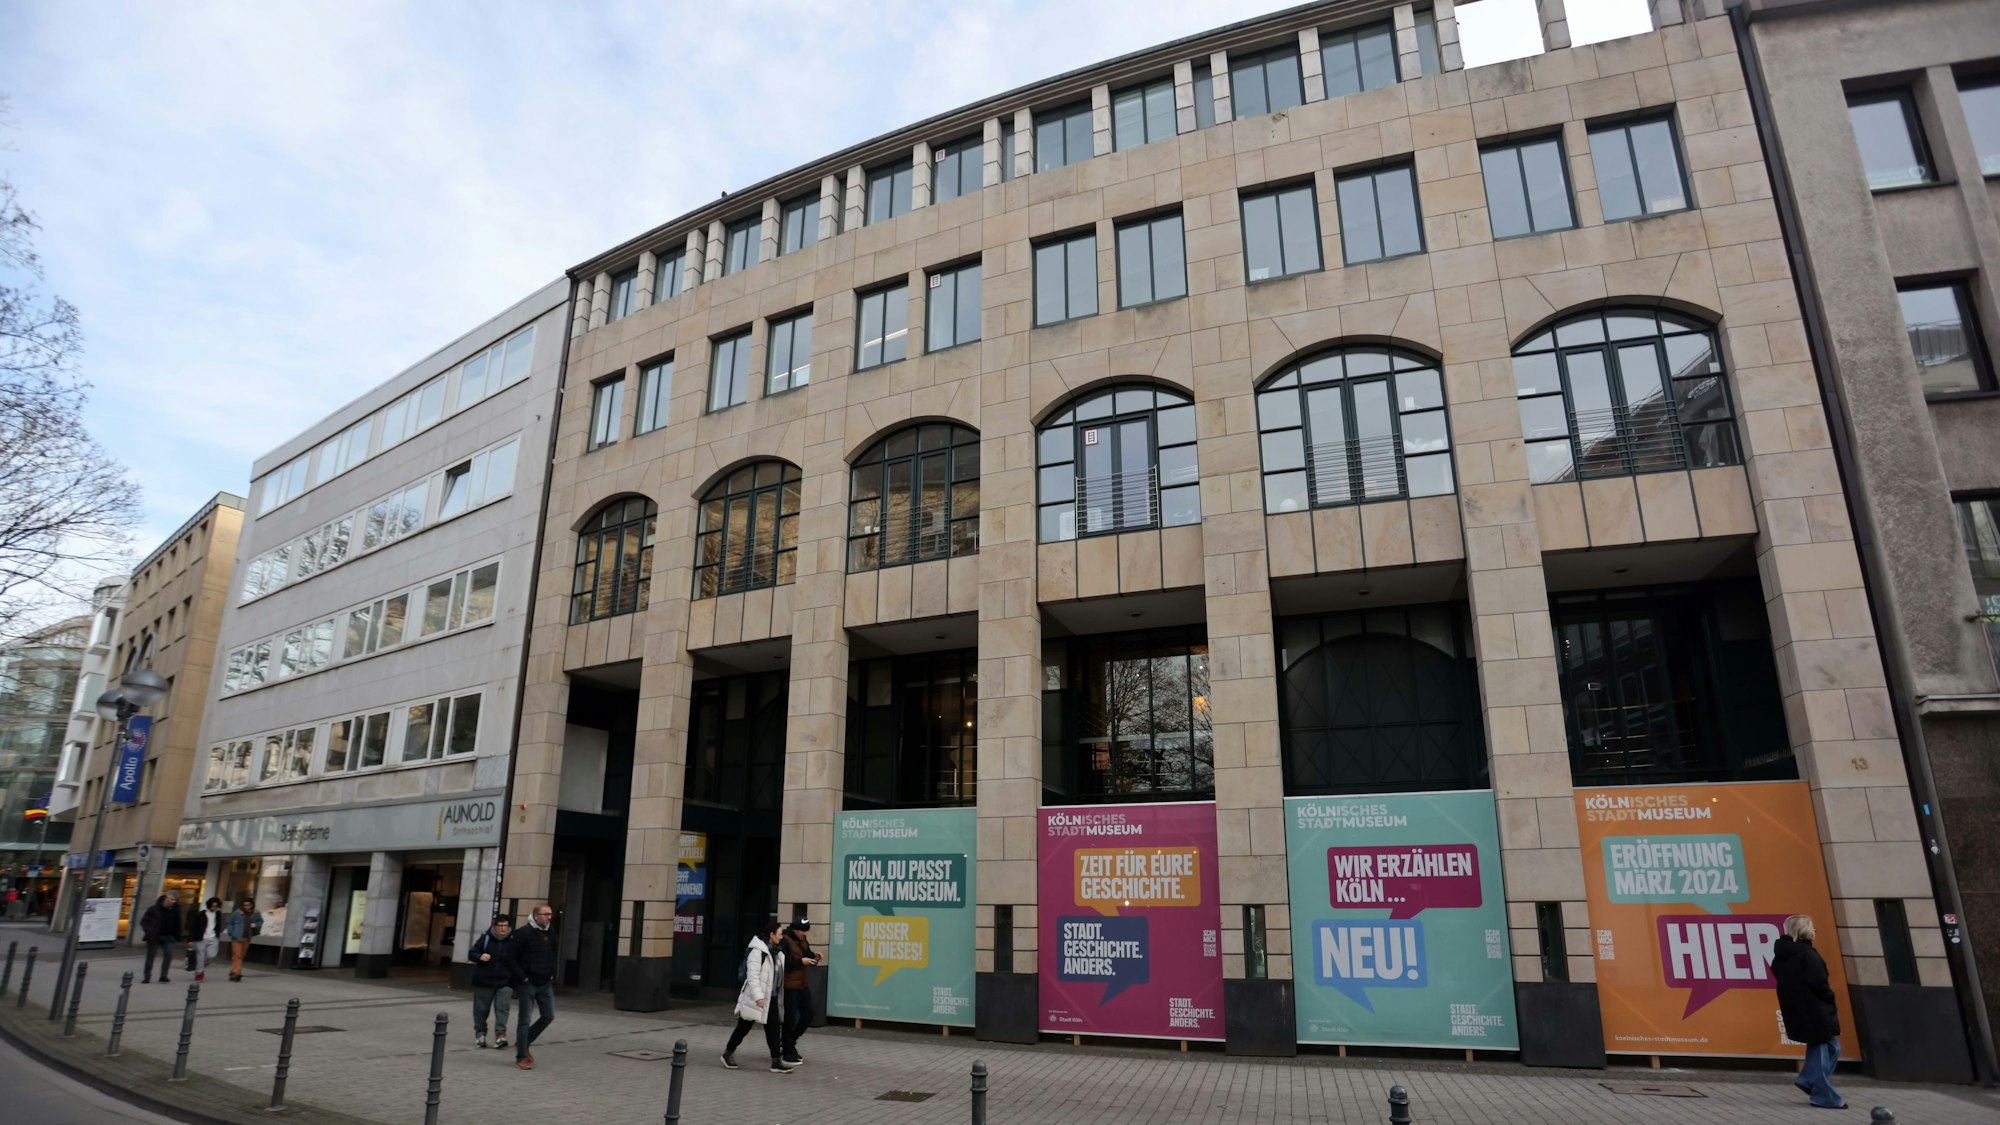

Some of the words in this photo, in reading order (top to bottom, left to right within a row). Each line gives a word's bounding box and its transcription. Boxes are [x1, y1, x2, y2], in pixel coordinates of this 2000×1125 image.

[1851, 757, 1869, 771] 13
[120, 757, 138, 790] Apollo
[1585, 794, 1688, 810] KÖLNISCHES
[443, 802, 495, 824] AUNOLD
[1297, 804, 1388, 818] KÖLNISCHES
[1586, 807, 1711, 821] STADTMUSEUM
[842, 817, 905, 829] KÖLNISCHES
[1048, 812, 1126, 826] KÖLNISCHES
[1298, 815, 1408, 829] STADTMUSEUM
[842, 828, 918, 838] STADTMUSEUM
[1048, 824, 1142, 836] STADTMUSEUM
[1610, 839, 1733, 869] ERÖFFNUNG
[848, 856, 885, 881] KÖLN,
[887, 860, 906, 880] DU
[908, 860, 952, 880] PASST
[1080, 855, 1113, 877] ZEIT
[1116, 850, 1147, 876] FÜR
[1151, 854, 1193, 876] EURE
[1334, 854, 1373, 878] WIR
[1377, 848, 1472, 878] ERZÄHLEN
[1081, 877, 1186, 899] GESCHICHTE.
[1614, 869, 1675, 895] MÄRZ
[1680, 869, 1739, 894] 2024
[848, 881, 861, 900] IN
[864, 880, 893, 900] KEIN
[896, 881, 961, 902] MUSEUM.
[862, 921, 909, 940] AUSSER
[1063, 922, 1104, 940] STADT.
[862, 941, 875, 958] IN
[878, 941, 923, 960] DIESES!
[1063, 940, 1143, 959] GESCHICHTE.
[1320, 927, 1419, 980] NEU!
[1063, 958, 1116, 976] ANDERS.
[933, 987, 953, 997] STADT.
[932, 996, 970, 1006] GESCHICHTE.
[1169, 998, 1193, 1008] STADT.
[932, 1005, 958, 1015] ANDERS.
[1170, 1008, 1216, 1019] GESCHICHTE.
[1450, 1004, 1478, 1015] STADT.
[1169, 1018, 1200, 1028] ANDERS.
[1451, 1014, 1505, 1026] GESCHICHTE.
[1451, 1025, 1487, 1037] ANDERS.
